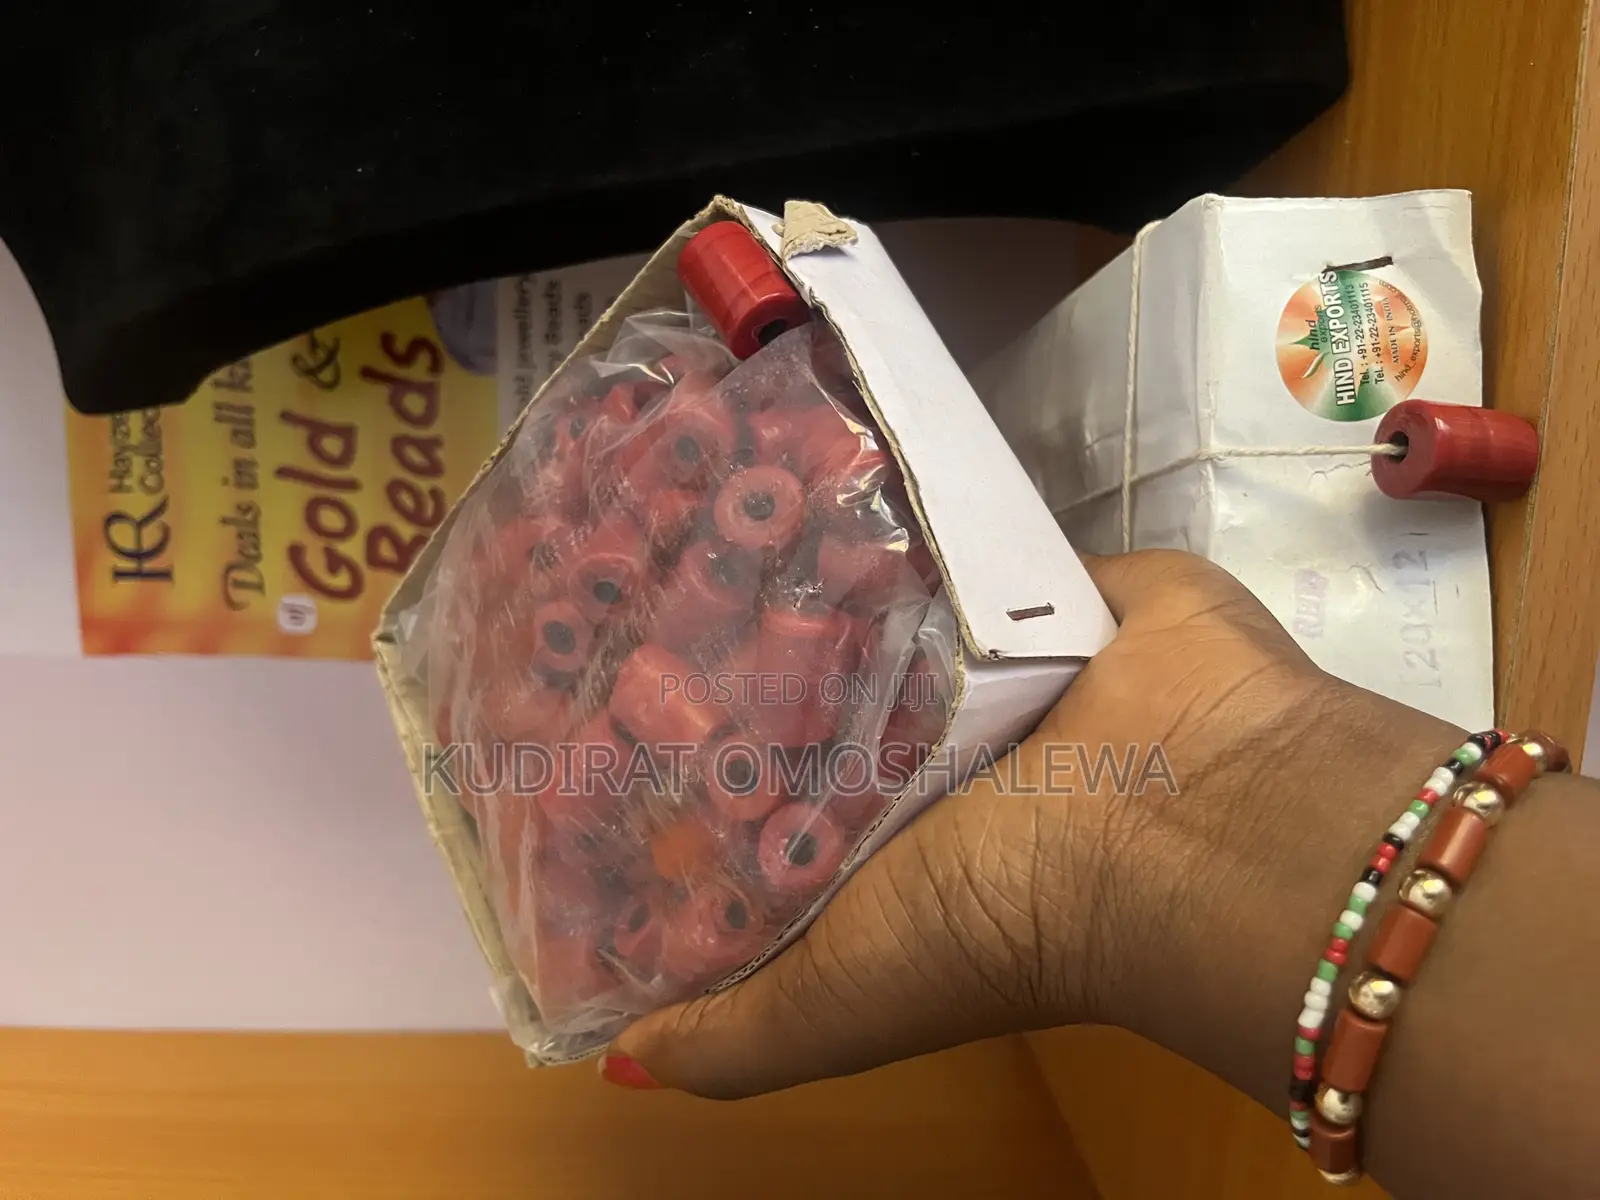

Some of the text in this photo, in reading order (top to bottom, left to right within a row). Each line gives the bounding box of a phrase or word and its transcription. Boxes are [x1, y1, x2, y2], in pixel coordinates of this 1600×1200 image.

[1314, 304, 1328, 344] exports
[1318, 269, 1356, 407] HIND EXPORTS
[1358, 282, 1383, 358] +91-22-23401115
[1382, 296, 1400, 364] MADE IN INDIA
[1374, 366, 1385, 385] Tel.
[213, 401, 256, 450] all
[360, 330, 447, 574] Beads
[222, 455, 260, 491] in
[273, 329, 364, 601] Gold &
[221, 498, 265, 610] Deals
